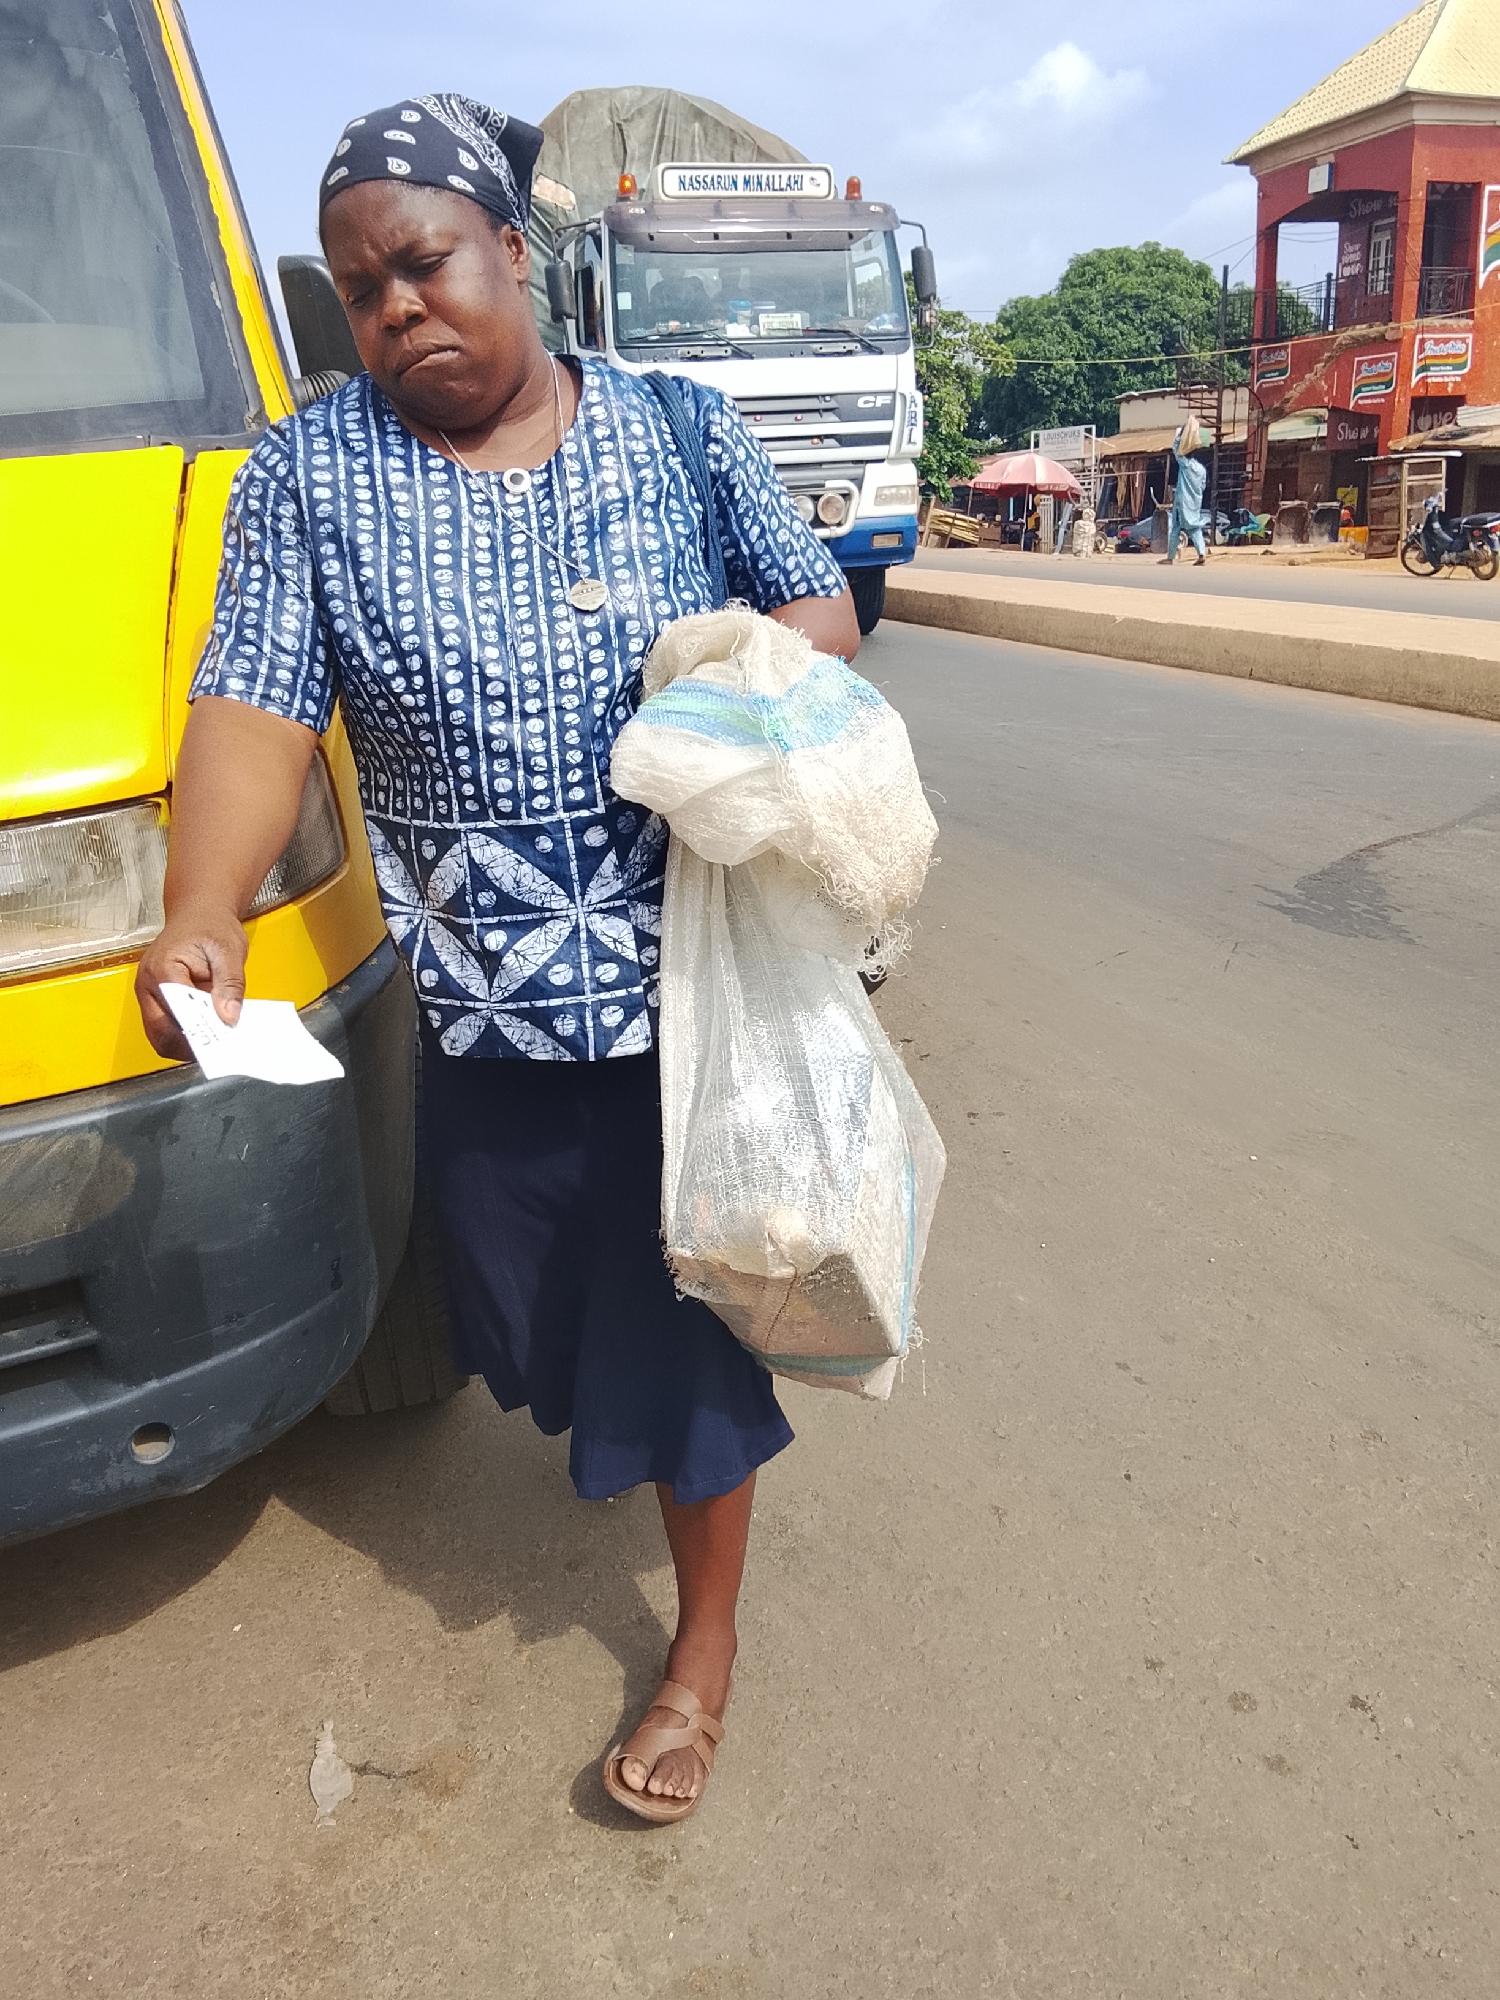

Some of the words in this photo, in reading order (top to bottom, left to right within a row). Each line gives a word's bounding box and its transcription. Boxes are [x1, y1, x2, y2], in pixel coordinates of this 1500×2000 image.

[678, 174, 738, 192] NASSARUN
[742, 174, 804, 192] MINALLAHI
[857, 395, 893, 408] CF
